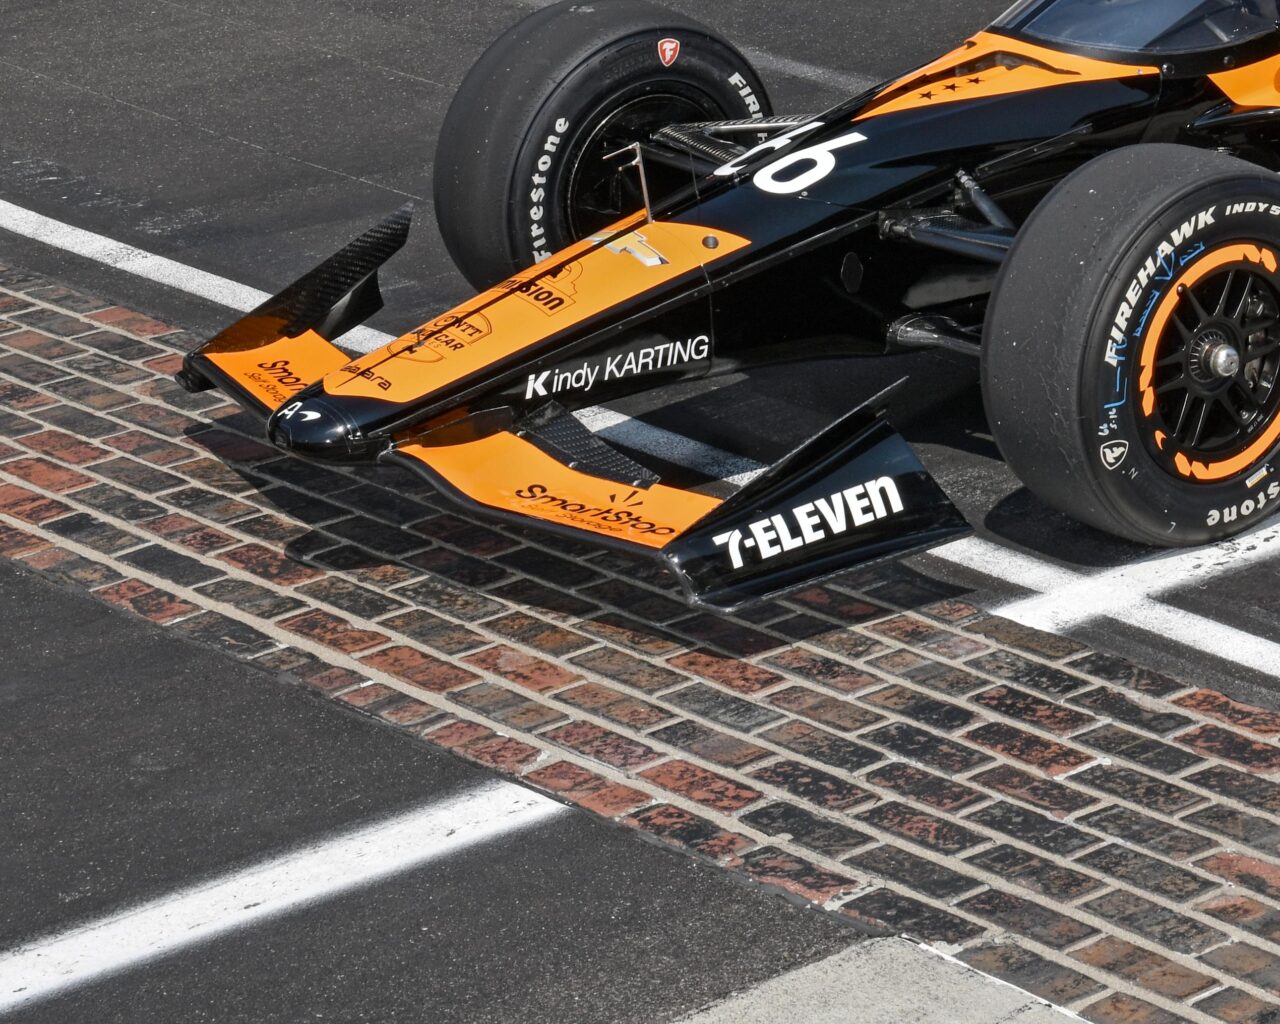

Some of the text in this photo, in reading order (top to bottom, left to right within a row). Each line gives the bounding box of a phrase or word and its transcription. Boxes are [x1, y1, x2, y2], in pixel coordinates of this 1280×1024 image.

[529, 117, 570, 265] Firestone
[1104, 205, 1217, 367] FIREHAWK
[1225, 202, 1269, 216] INDY
[604, 335, 710, 382] KARTING
[515, 484, 676, 536] SmartStop
